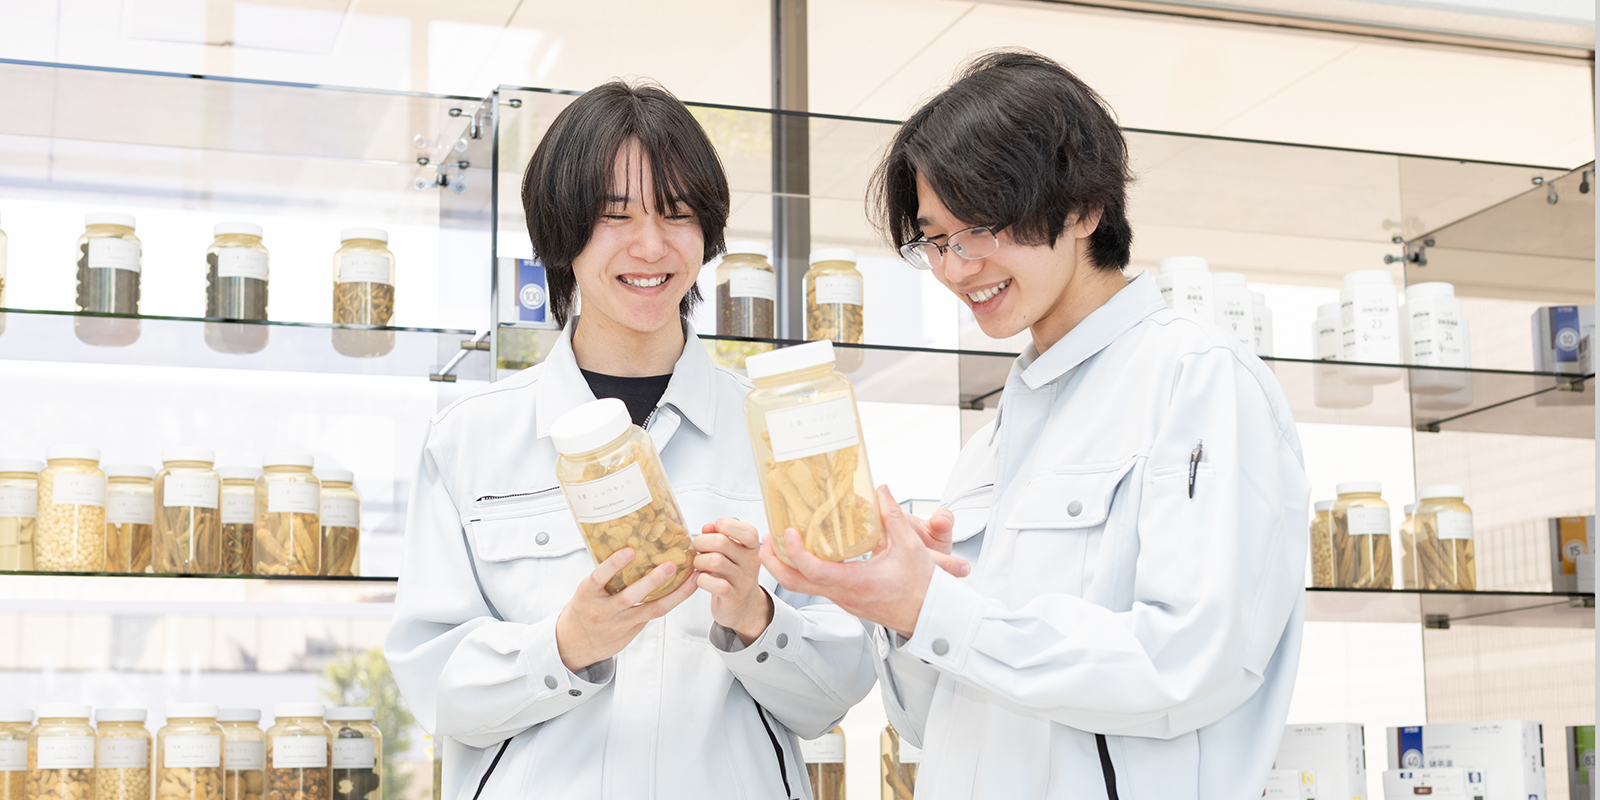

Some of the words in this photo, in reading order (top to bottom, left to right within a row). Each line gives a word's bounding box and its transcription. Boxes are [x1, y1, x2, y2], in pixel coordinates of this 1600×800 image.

[525, 291, 541, 303] 100
[1231, 322, 1238, 332] 9
[1371, 319, 1383, 329] 23
[1563, 334, 1574, 345] 10
[594, 480, 631, 498] ショウキョウ
[1570, 545, 1581, 556] 15
[1408, 756, 1418, 768] 40
